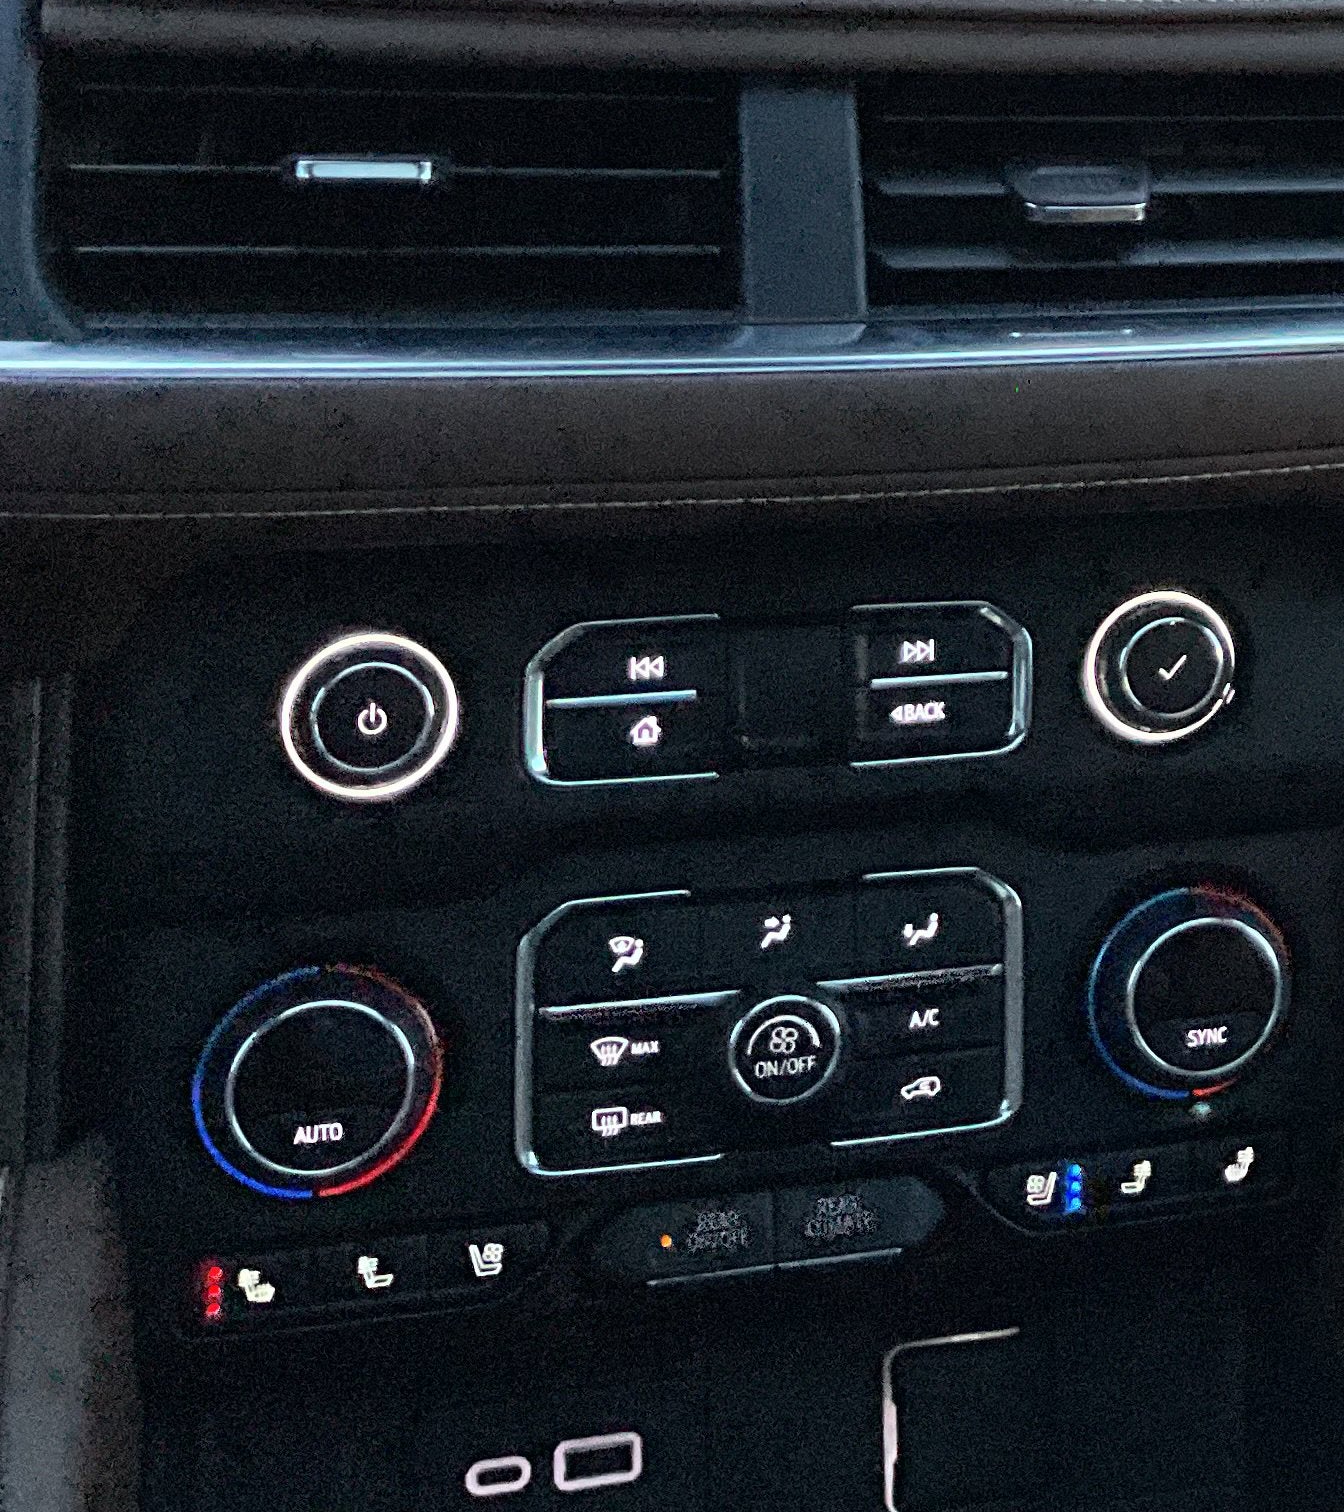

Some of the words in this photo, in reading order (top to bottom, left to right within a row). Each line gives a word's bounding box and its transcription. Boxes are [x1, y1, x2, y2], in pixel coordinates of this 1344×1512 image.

[903, 700, 946, 723] BACK
[908, 1008, 940, 1029] A/C
[630, 1040, 660, 1055] MAX
[1187, 1026, 1228, 1048] SYNC
[754, 1055, 817, 1079] ON/OFF
[629, 1110, 662, 1126] REAR
[293, 1121, 344, 1146] AUTO
